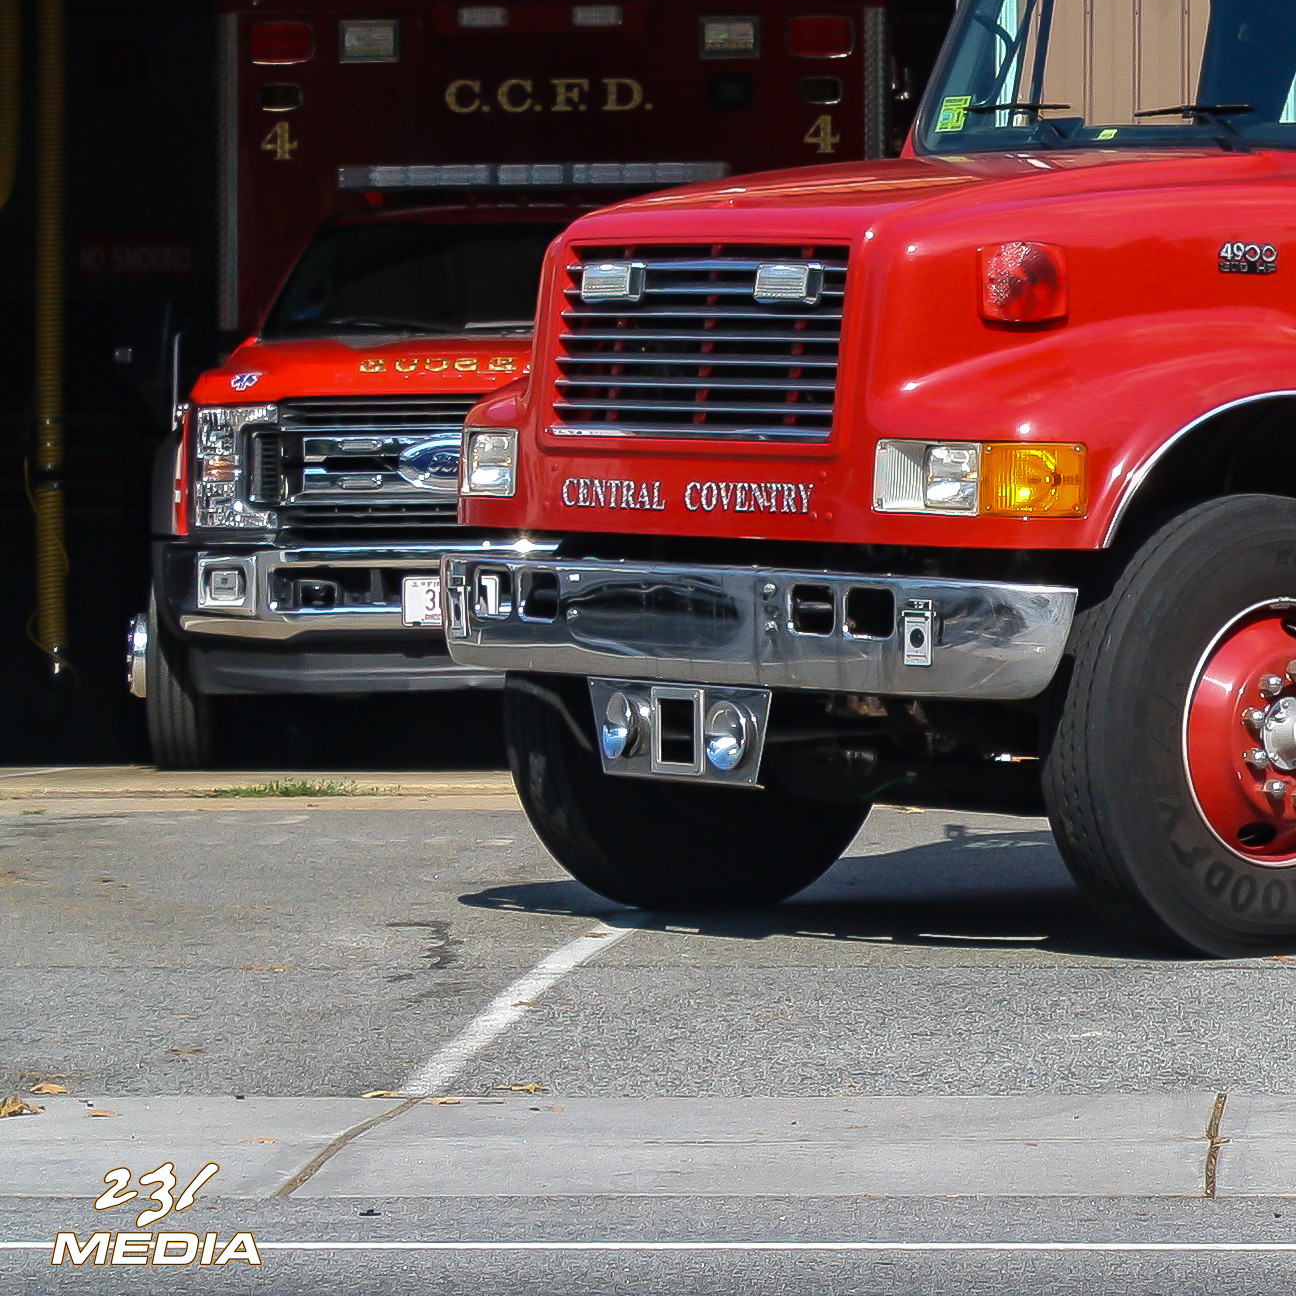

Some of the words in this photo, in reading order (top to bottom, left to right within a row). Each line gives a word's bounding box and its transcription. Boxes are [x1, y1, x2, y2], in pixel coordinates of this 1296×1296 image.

[261, 121, 299, 161] 4
[803, 114, 841, 154] 4
[1219, 241, 1278, 263] 4900
[562, 477, 666, 510] CENTRAL
[684, 481, 815, 514] COVENTRY
